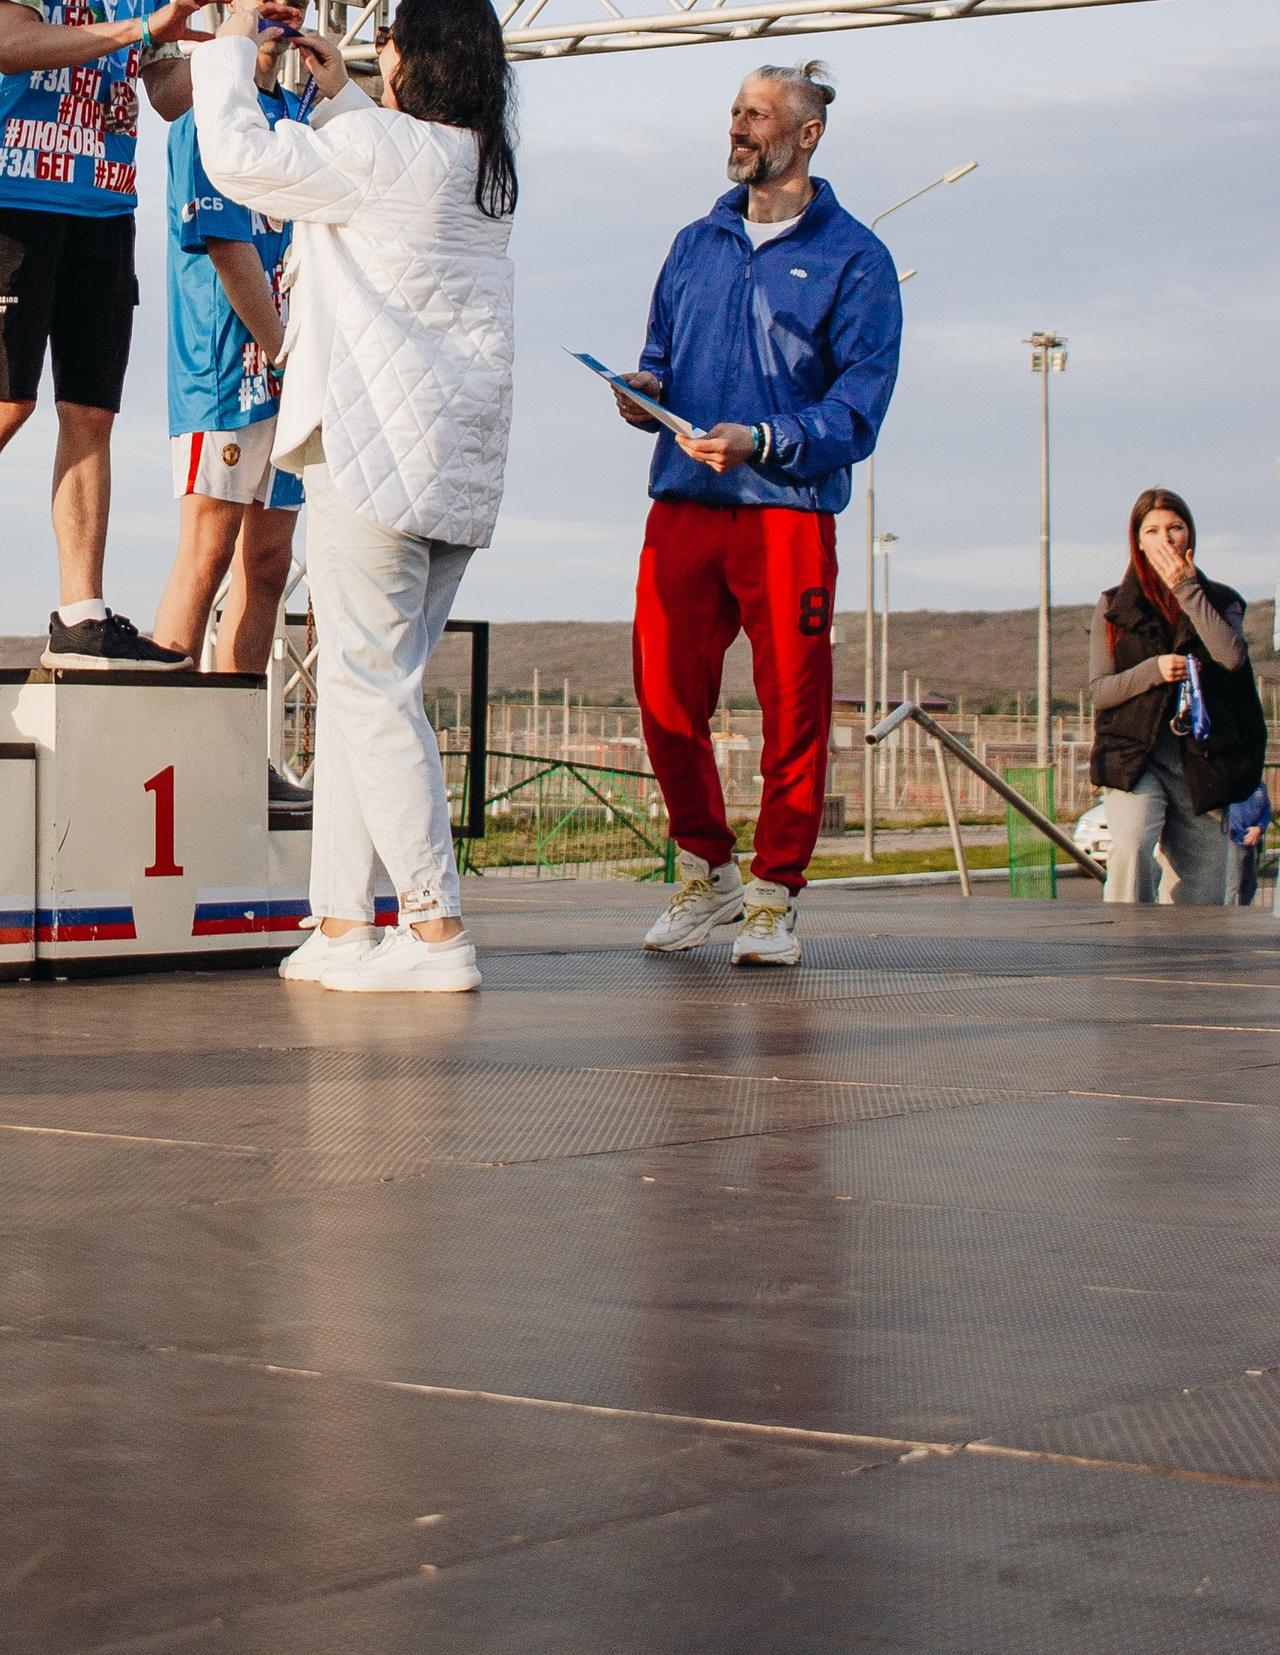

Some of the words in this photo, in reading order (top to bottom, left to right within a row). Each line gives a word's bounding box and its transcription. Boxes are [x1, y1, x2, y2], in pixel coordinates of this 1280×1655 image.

[30, 67, 102, 100] #ЗАБЕГ
[4, 119, 105, 159] #ЛЮБОВЬ
[799, 587, 830, 636] 8
[144, 765, 184, 877] 1
